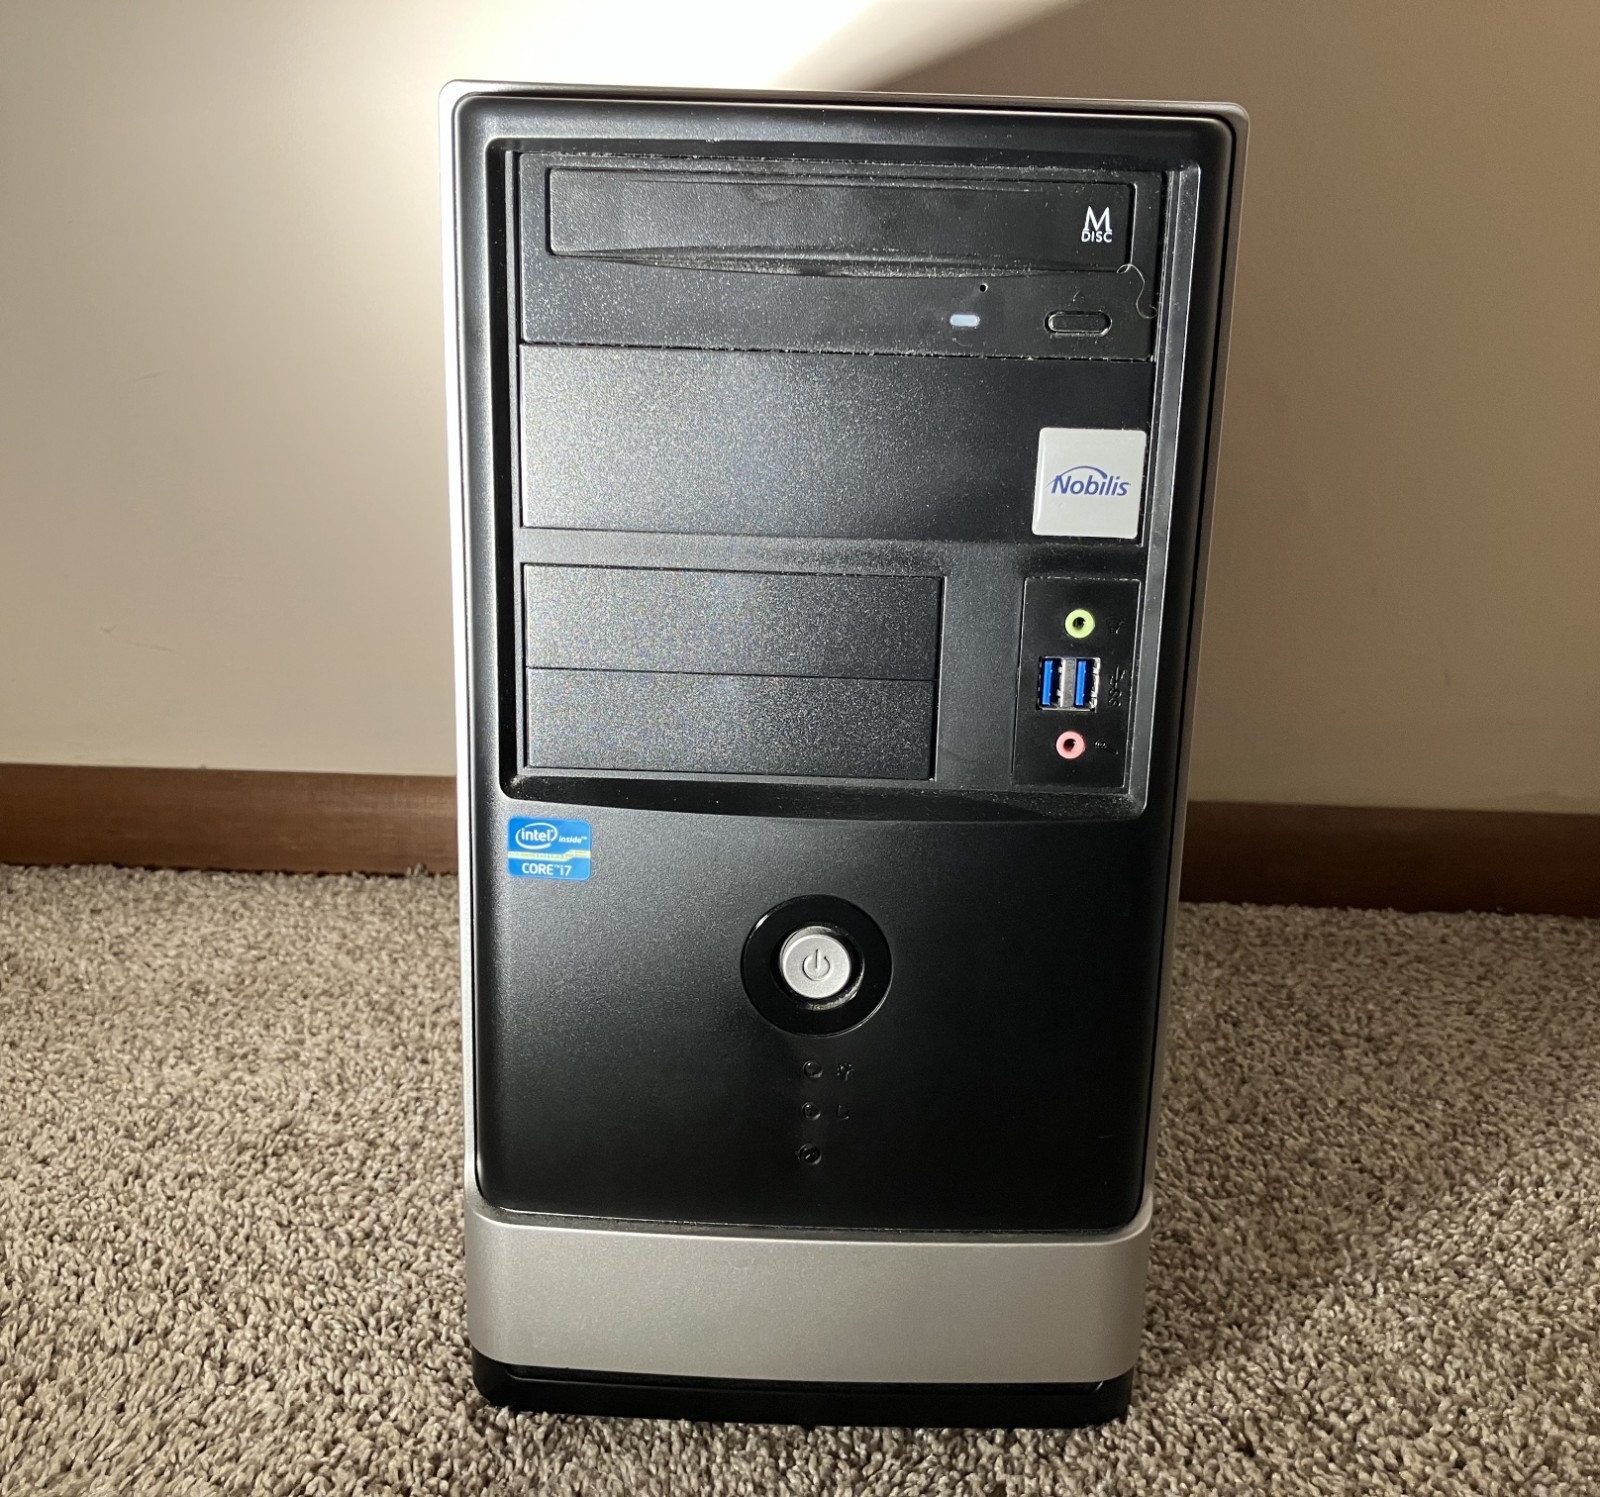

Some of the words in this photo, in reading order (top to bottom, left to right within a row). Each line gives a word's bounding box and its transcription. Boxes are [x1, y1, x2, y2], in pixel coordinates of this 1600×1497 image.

[1083, 205, 1112, 231] M
[1081, 230, 1112, 243] DISC
[1051, 474, 1131, 496] Nobilis
[521, 828, 551, 842] intel
[560, 864, 572, 876] i7
